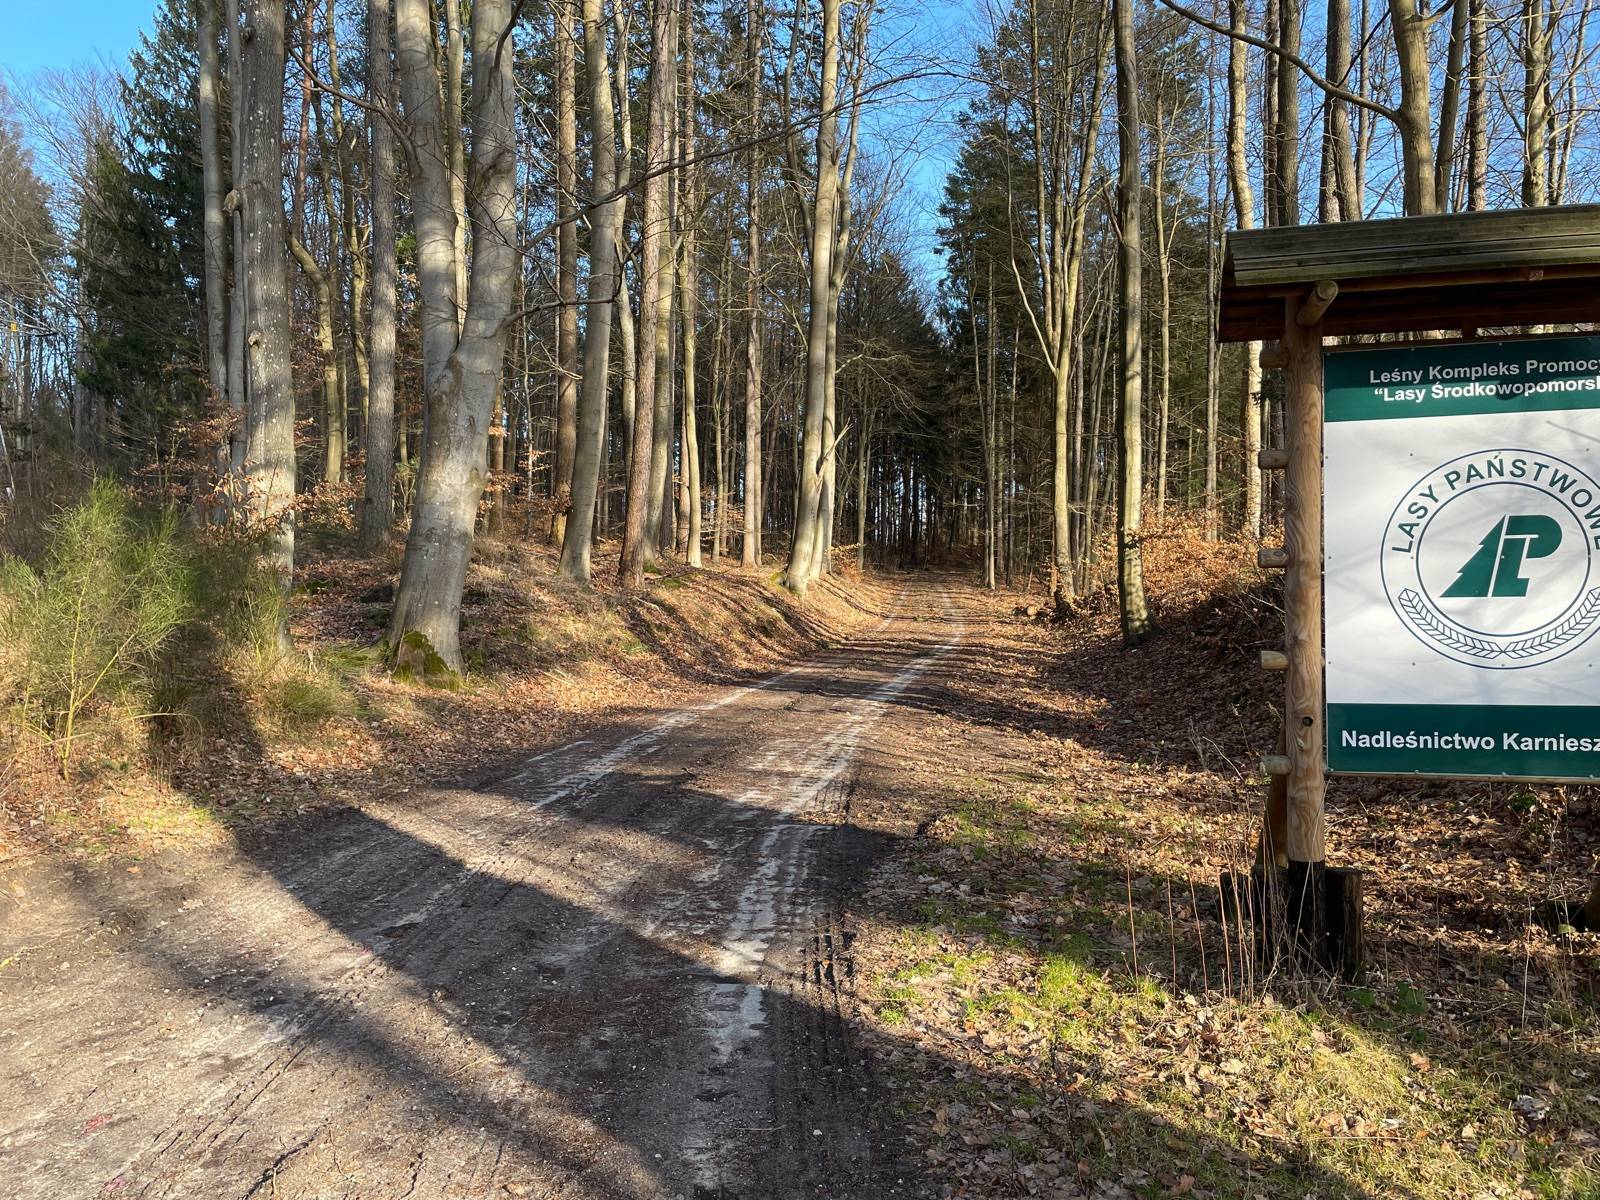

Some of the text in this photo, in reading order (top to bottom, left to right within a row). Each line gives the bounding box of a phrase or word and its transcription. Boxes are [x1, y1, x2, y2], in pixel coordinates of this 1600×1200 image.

[1370, 359, 1600, 384] Leśny Kompleks Promoc
[1391, 484, 1440, 553] LASY
[1341, 729, 1495, 750] Nadleśnictwo
